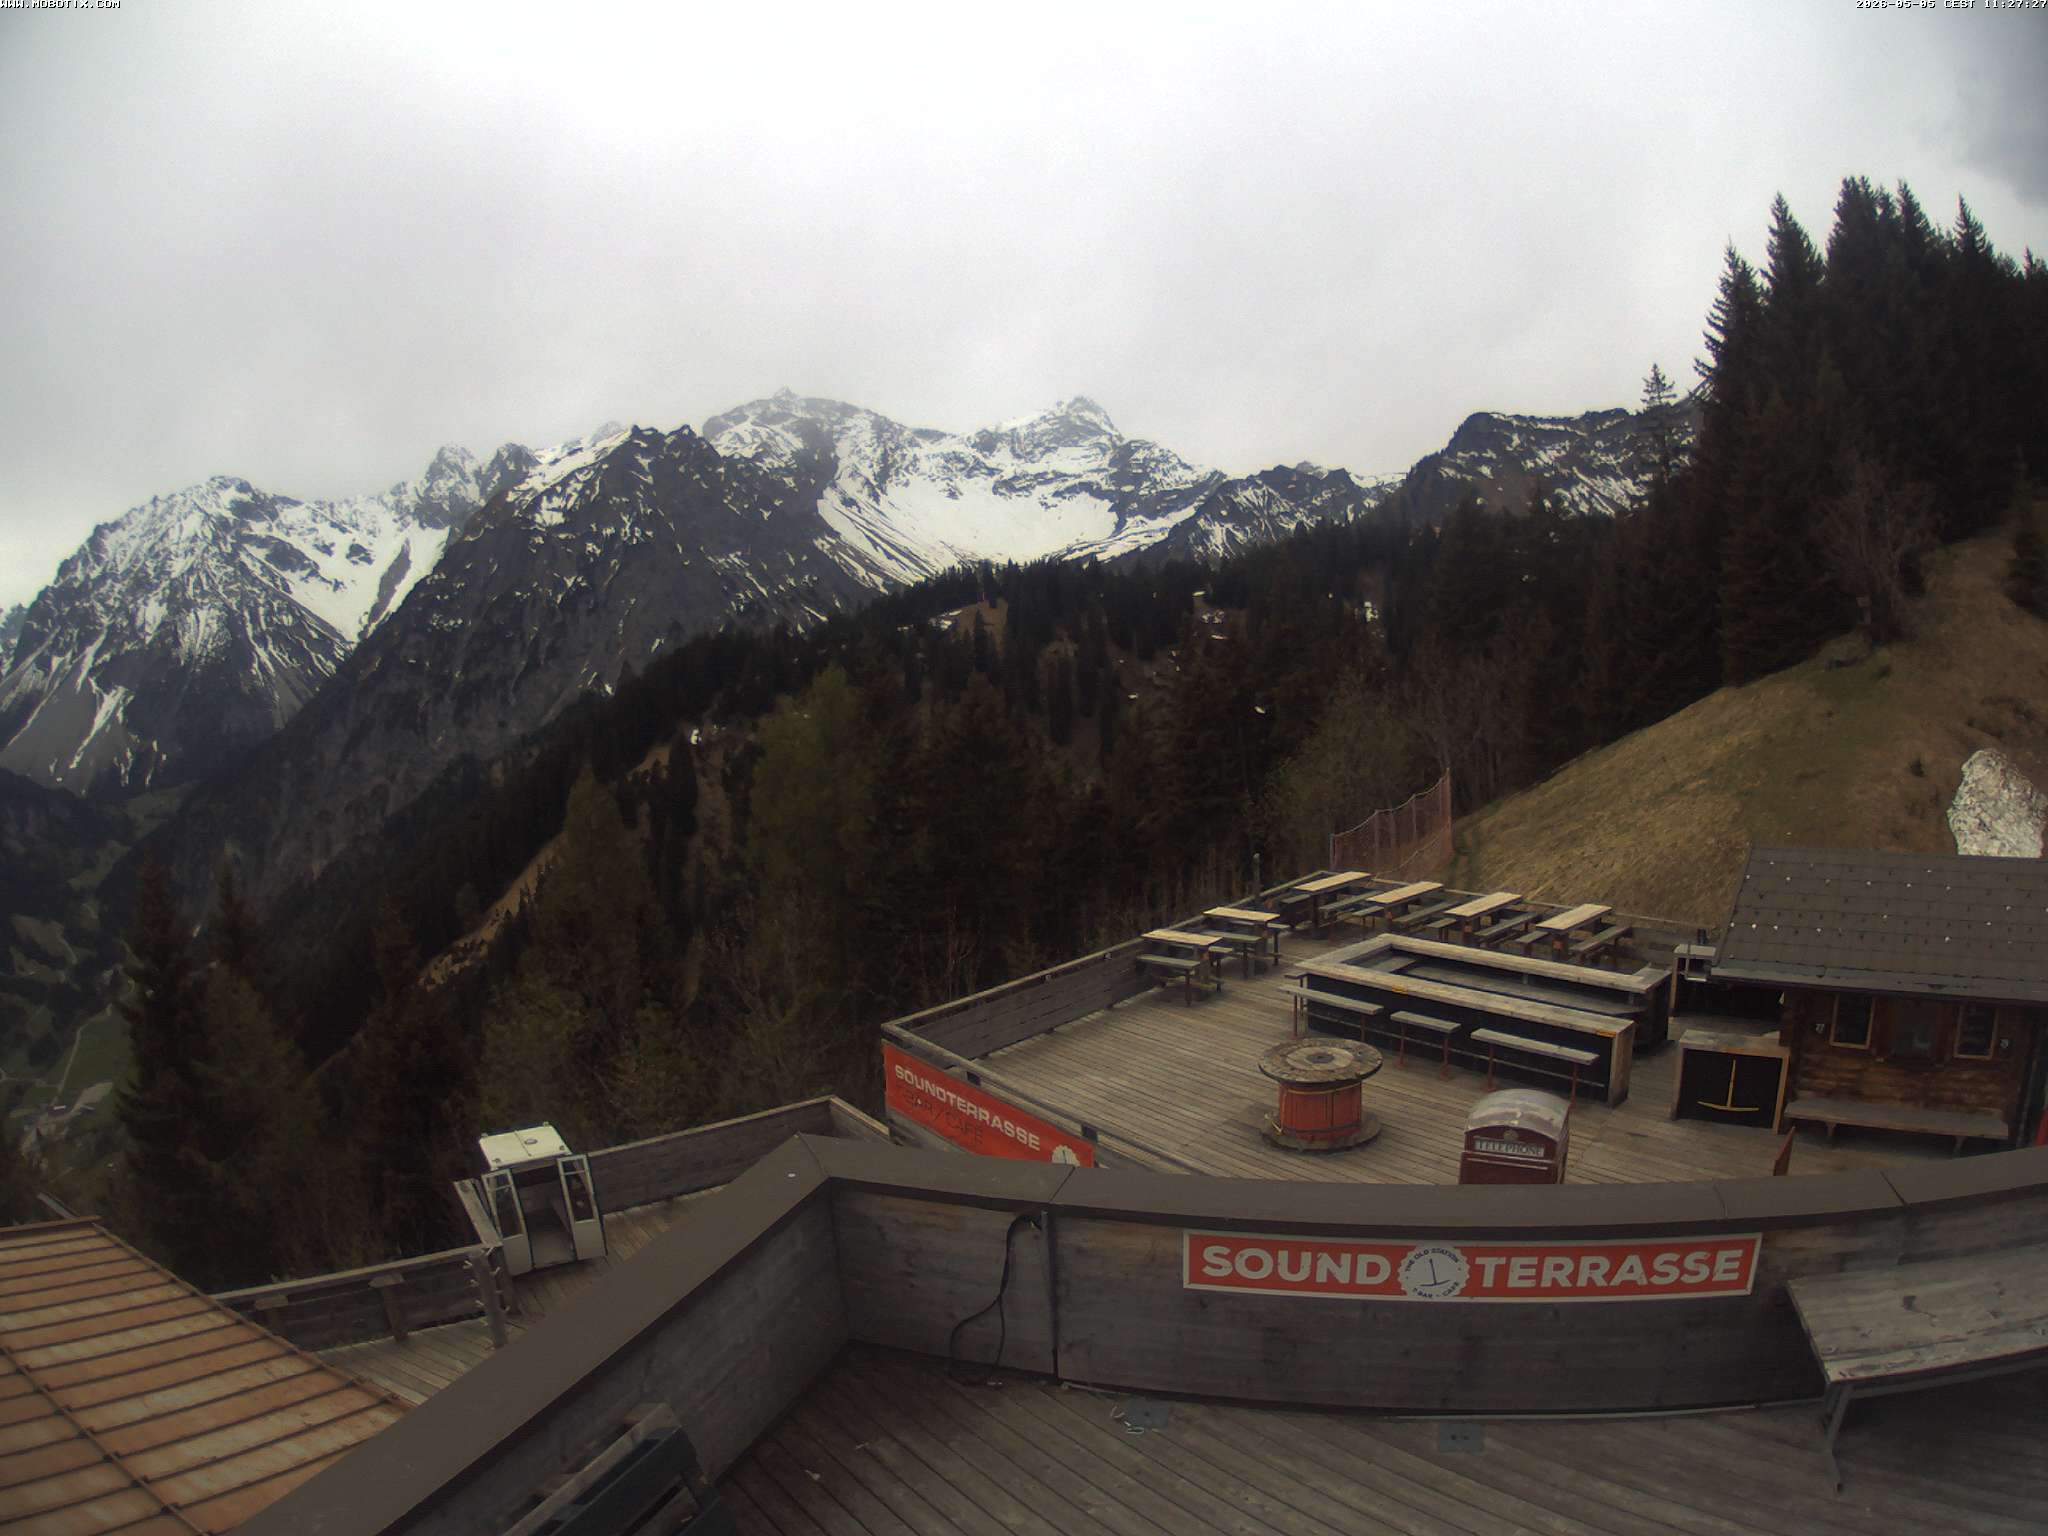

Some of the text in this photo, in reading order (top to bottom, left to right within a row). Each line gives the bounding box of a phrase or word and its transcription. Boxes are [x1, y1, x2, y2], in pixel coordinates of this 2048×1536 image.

[894, 1064, 1041, 1151] SOUNDTERRASSE
[1477, 1140, 1543, 1157] TELEPHONE
[1201, 1244, 1744, 1289] SOUND TERRASSE
